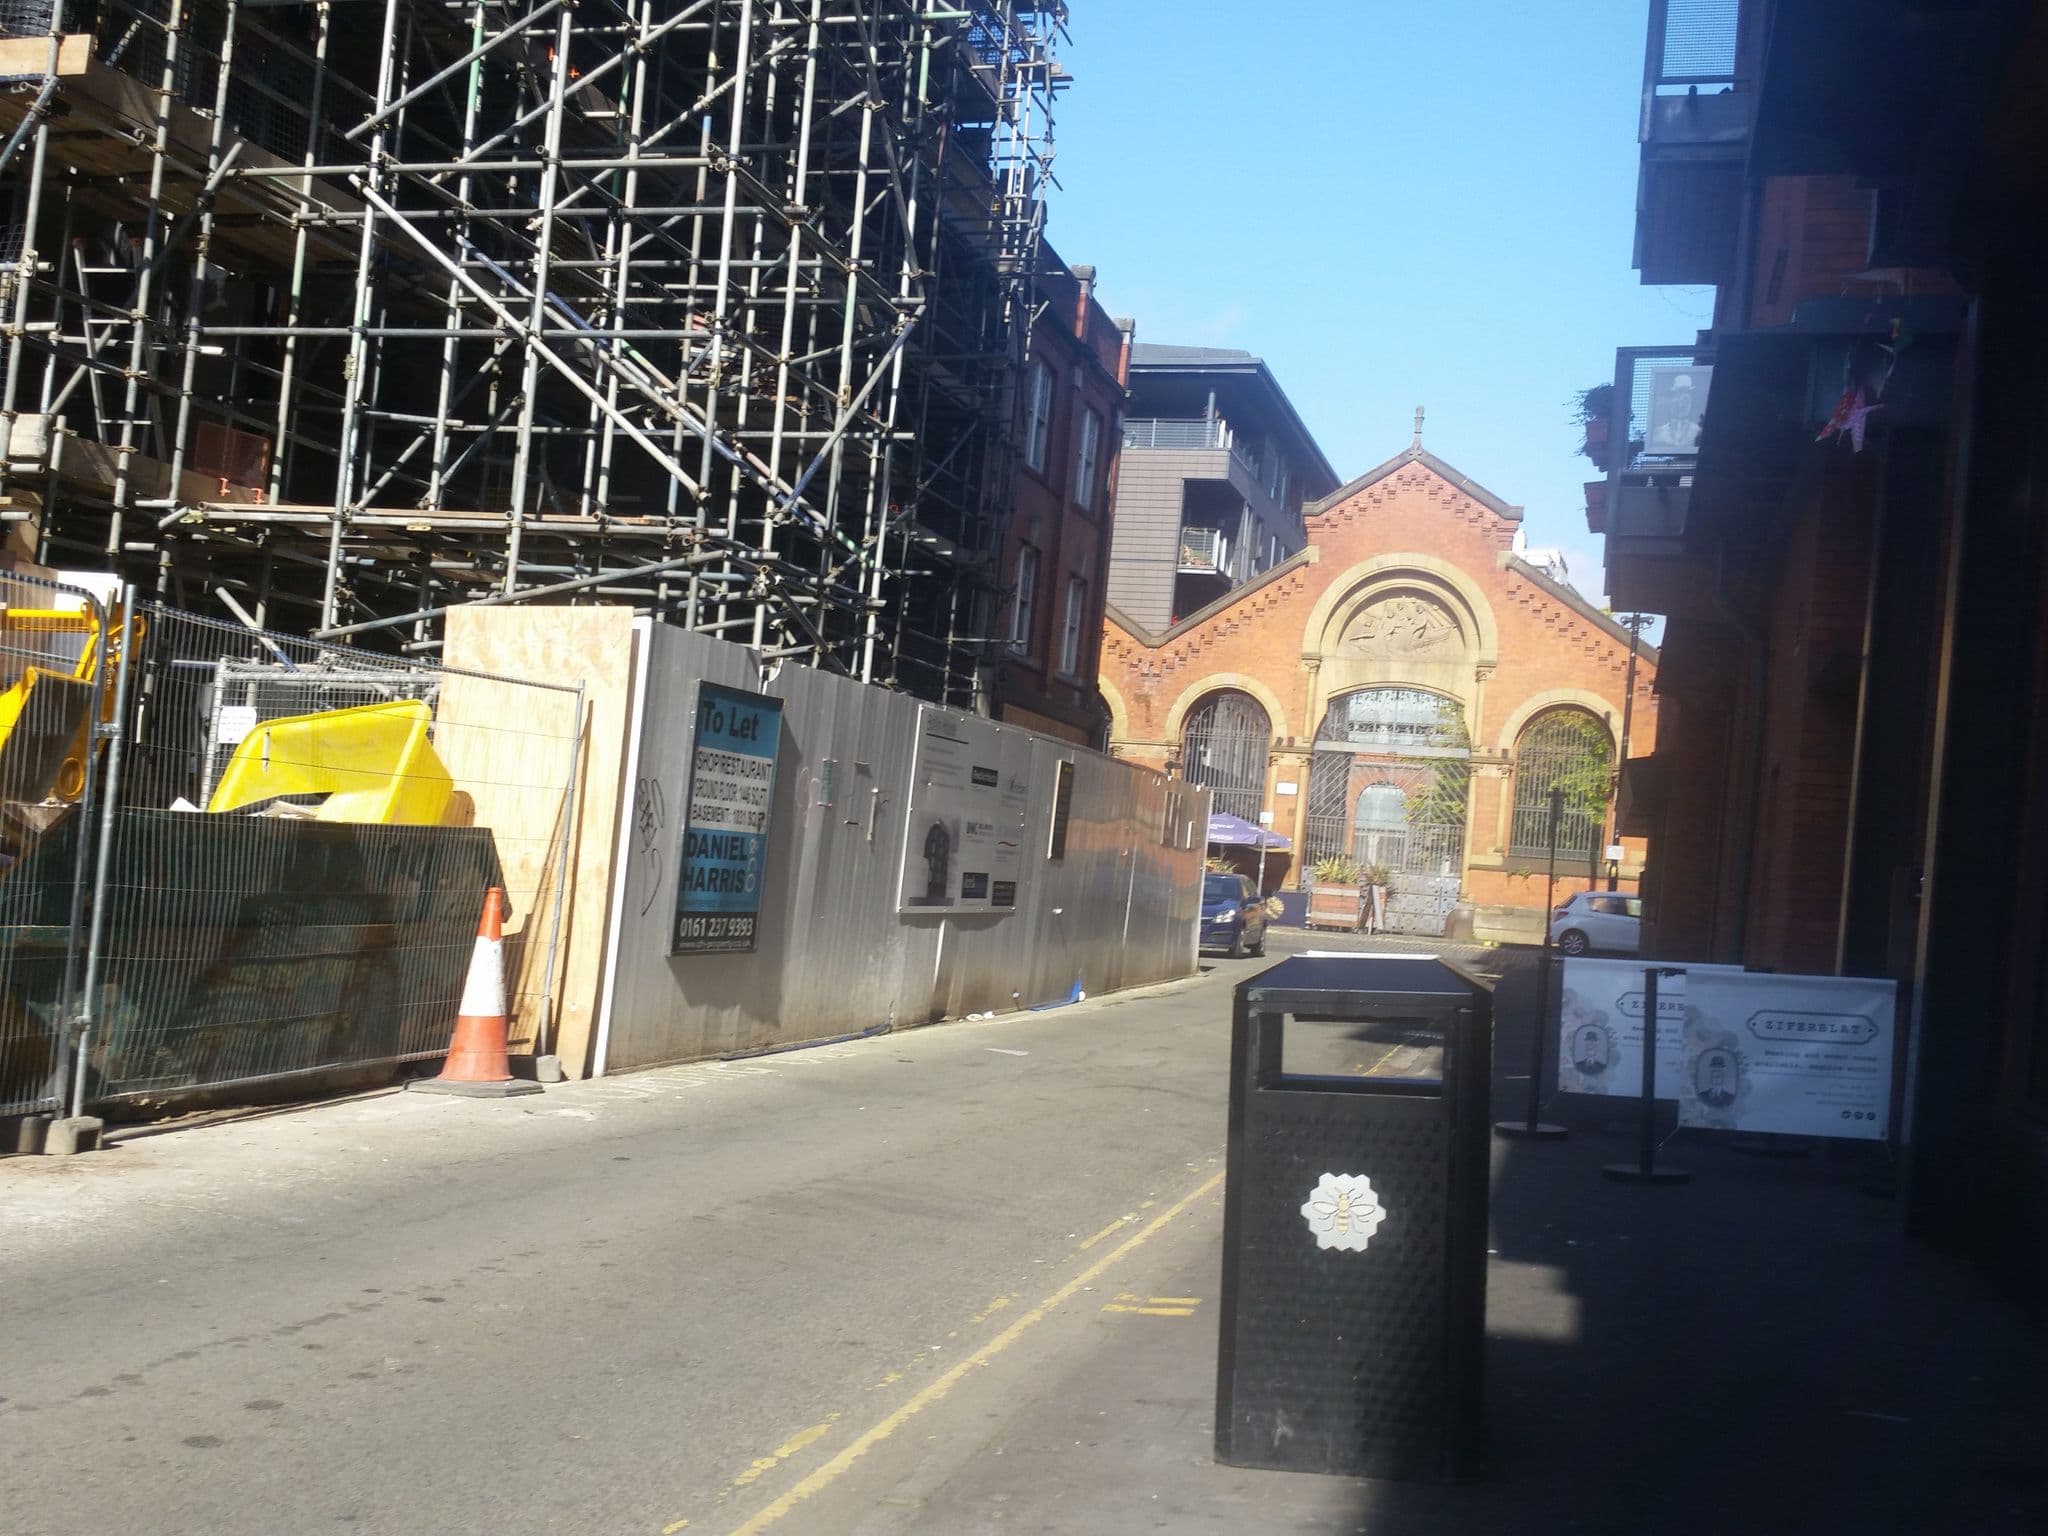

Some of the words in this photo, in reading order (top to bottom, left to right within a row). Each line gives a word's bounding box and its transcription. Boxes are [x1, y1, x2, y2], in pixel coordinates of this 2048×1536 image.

[703, 700, 725, 735] To
[728, 706, 759, 741] Let
[686, 832, 748, 860] DANIEL
[682, 866, 745, 893] HARRIS
[680, 917, 707, 937] 0161
[708, 917, 728, 937] 237
[728, 917, 754, 937] 9393
[1765, 1020, 1862, 1035] ZIFERBLAT
